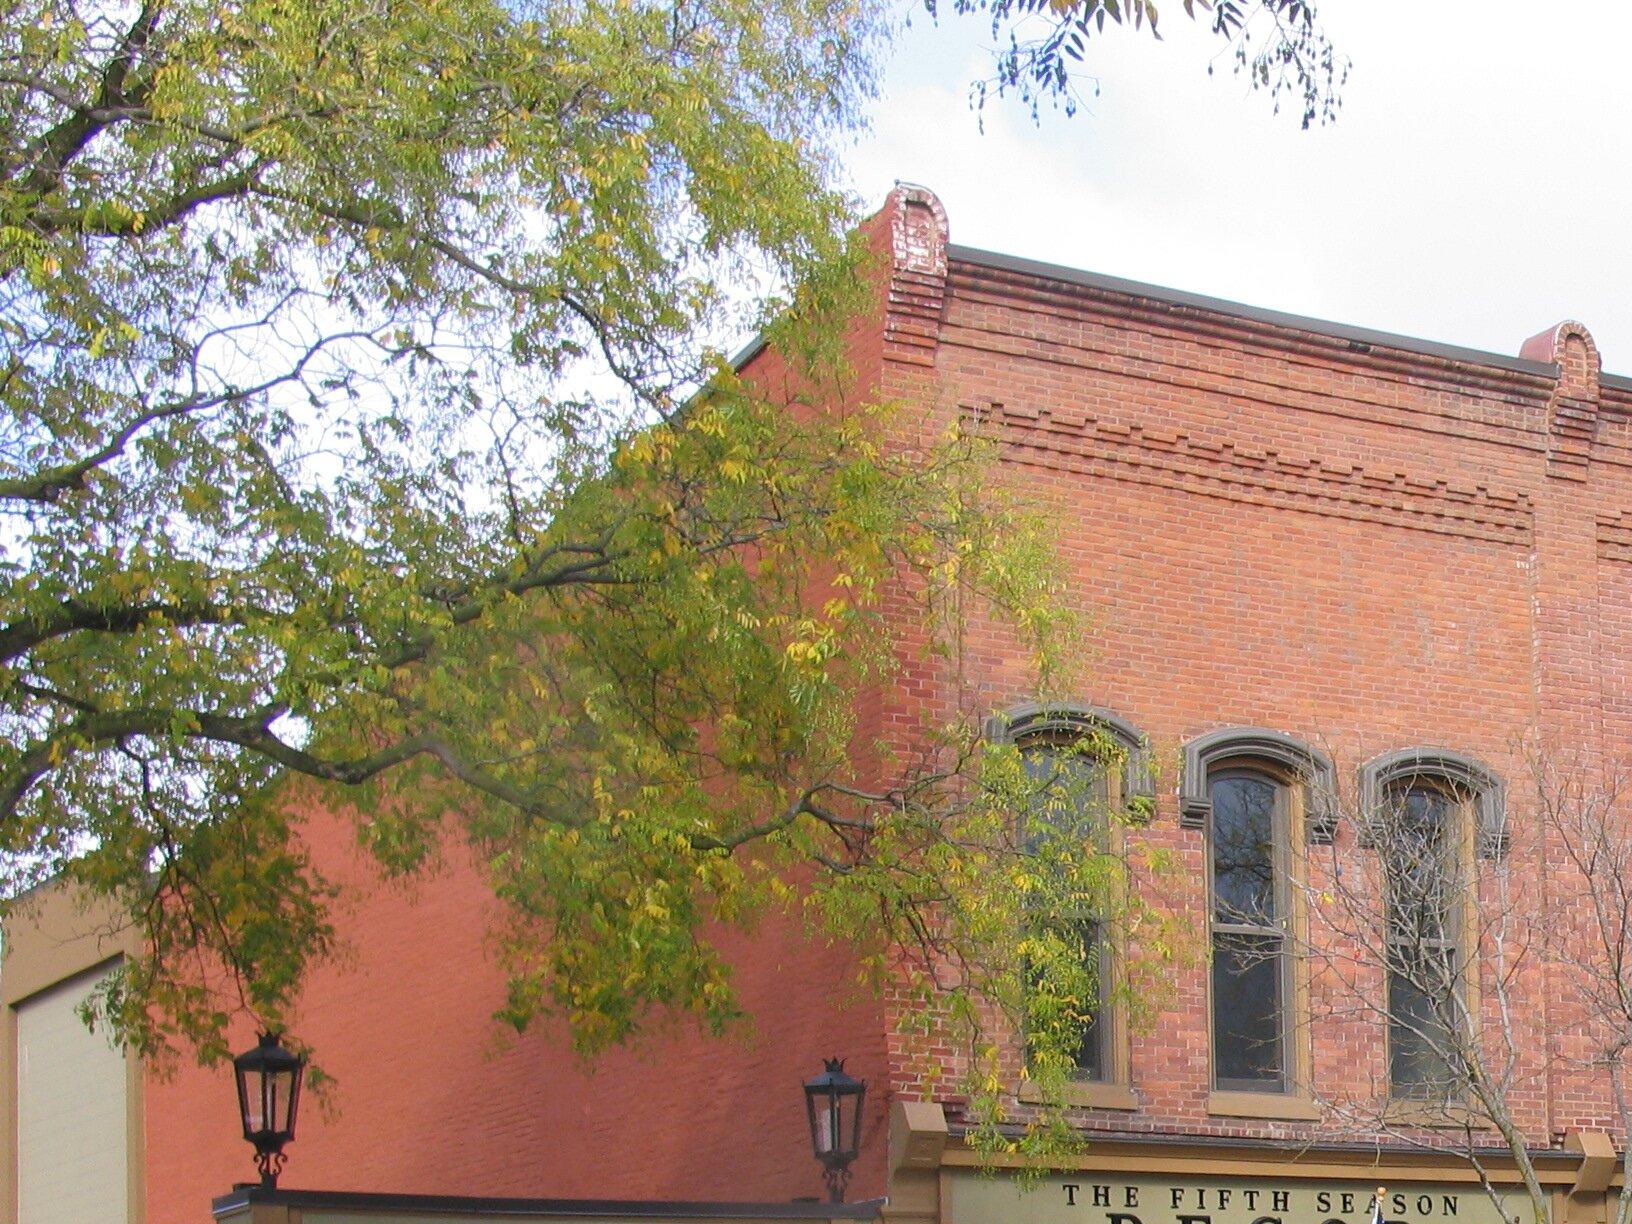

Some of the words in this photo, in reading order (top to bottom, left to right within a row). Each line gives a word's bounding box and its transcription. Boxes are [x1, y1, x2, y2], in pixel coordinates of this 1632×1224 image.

[1063, 1185, 1139, 1207] THE
[1170, 1188, 1290, 1212] FIFTH
[1317, 1192, 1458, 1217] SEASON
